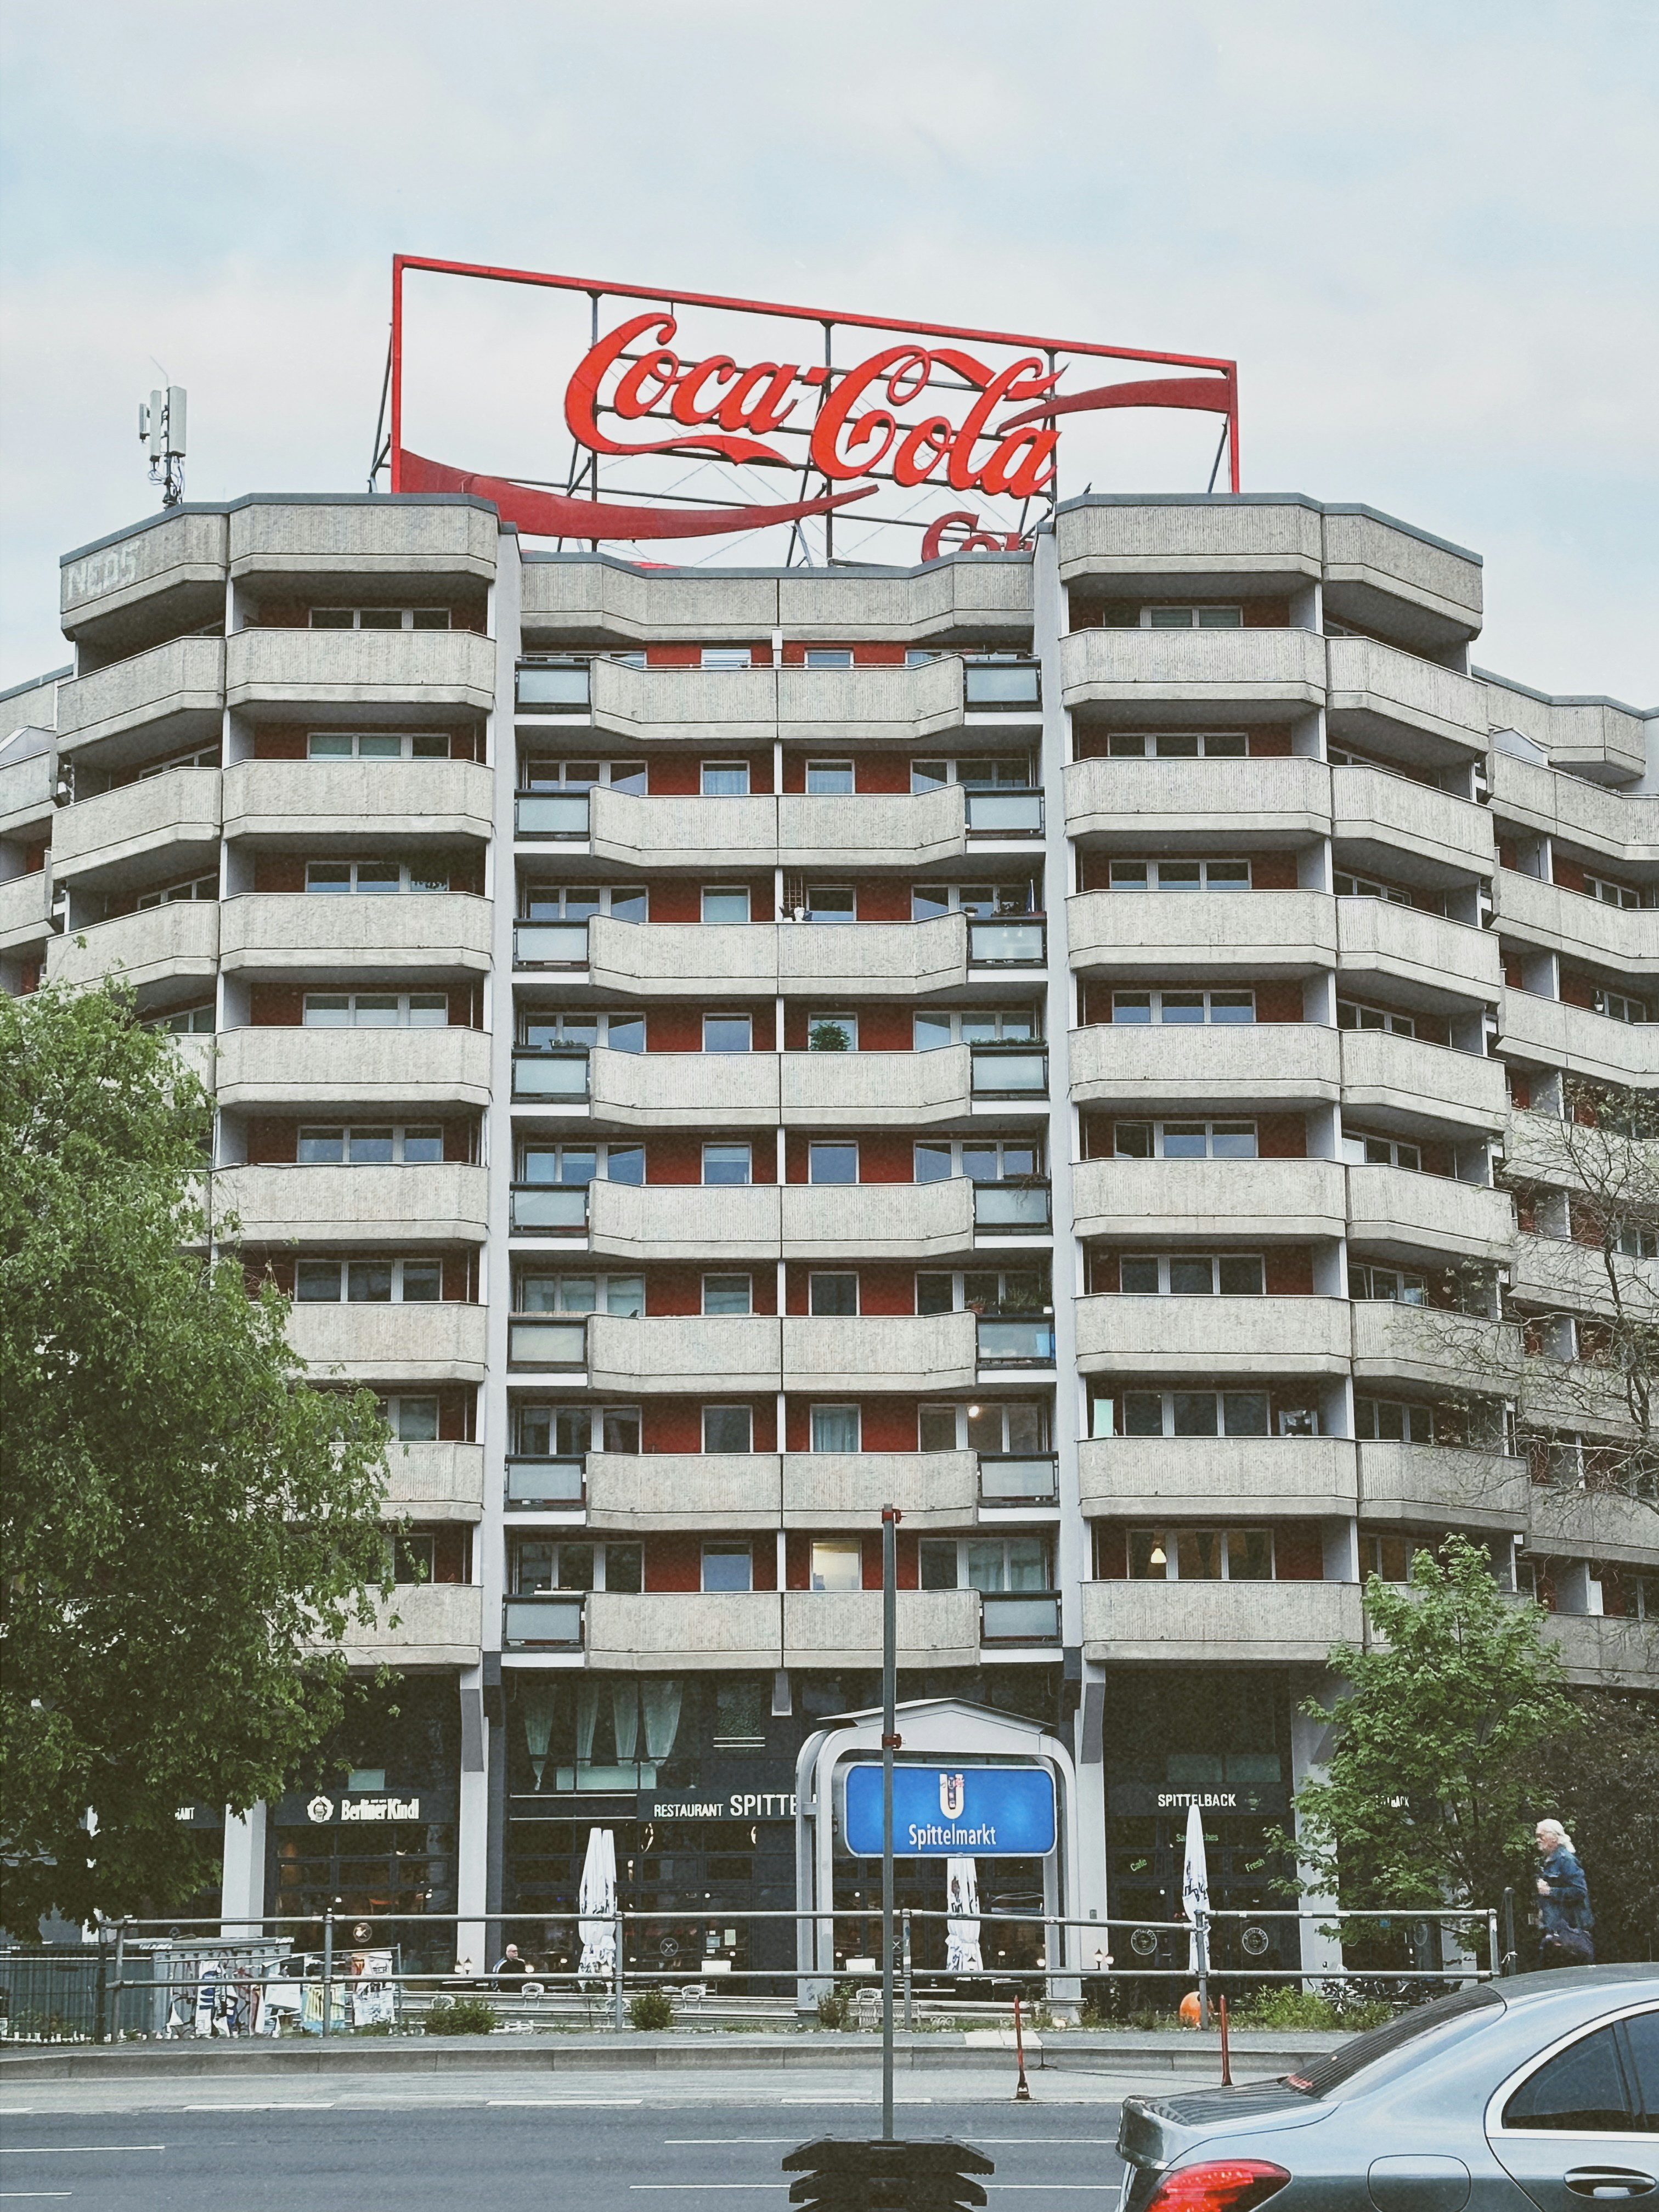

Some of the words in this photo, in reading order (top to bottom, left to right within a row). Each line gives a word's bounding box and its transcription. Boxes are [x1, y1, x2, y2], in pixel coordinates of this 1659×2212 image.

[565, 312, 1070, 500] Coca-Cola
[341, 1798, 387, 1820] Berliner
[387, 1798, 420, 1820] Kindl
[654, 1803, 724, 1817] RESTAURANT
[730, 1794, 817, 1816] SPITTE
[1158, 1793, 1236, 1807] SPITTELBACK
[909, 1823, 996, 1850] Spittelmarkt
[1245, 1858, 1265, 1872] Fresh
